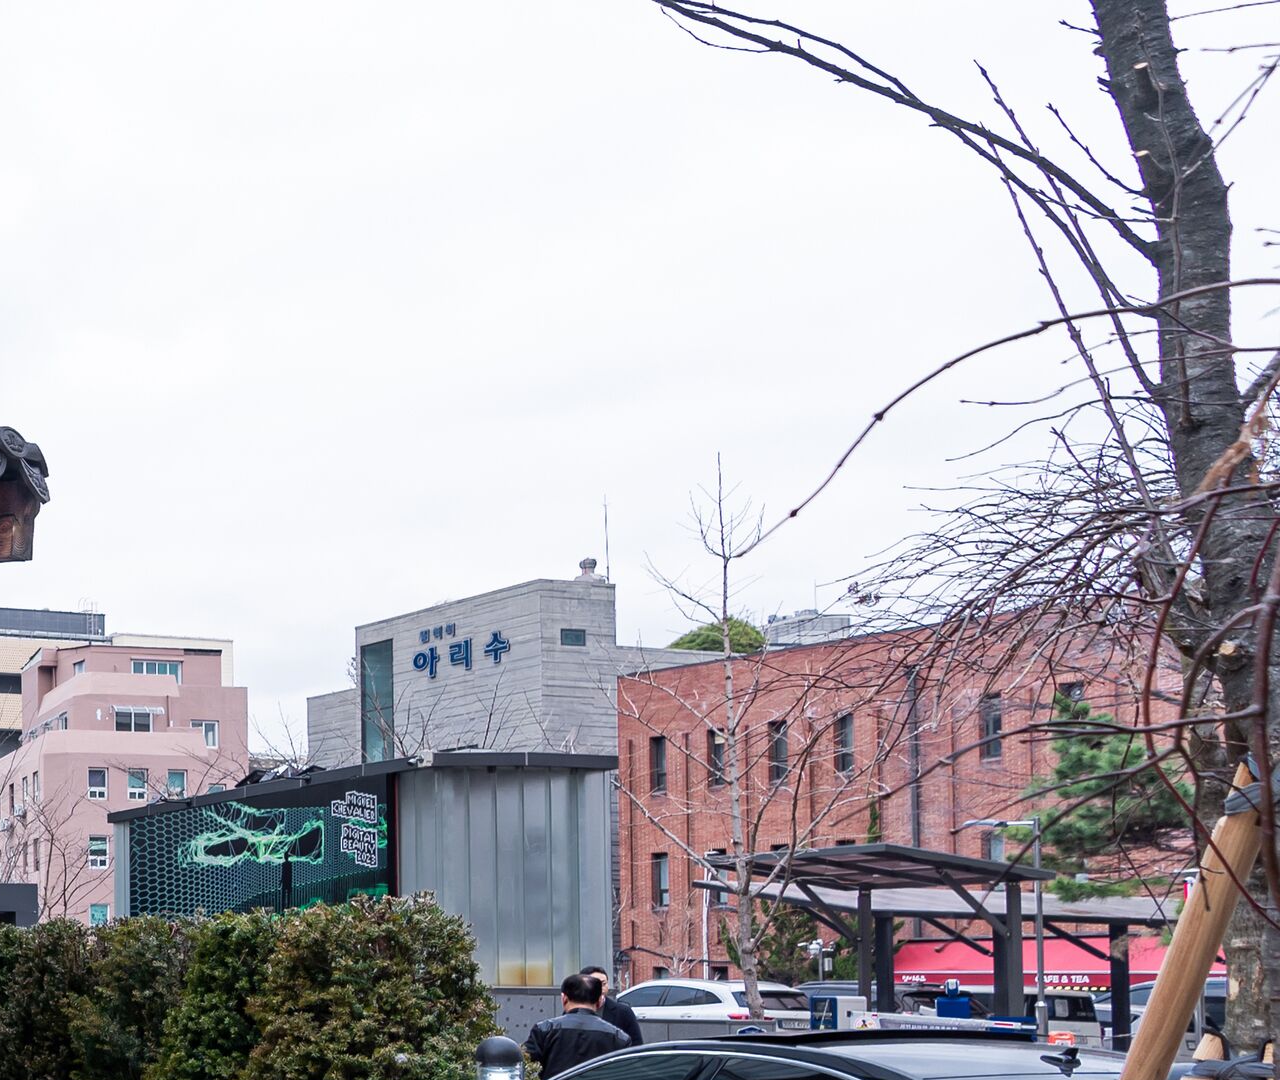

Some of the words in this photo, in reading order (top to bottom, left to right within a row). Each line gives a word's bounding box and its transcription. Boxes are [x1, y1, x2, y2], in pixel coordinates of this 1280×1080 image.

[412, 629, 510, 679] 아리수
[346, 795, 375, 809] MIGUEL
[333, 803, 375, 820] CHEVALIER
[342, 827, 375, 843] DIGITAL
[342, 839, 376, 854] BEAUTY
[357, 851, 376, 865] 2023
[1060, 974, 1068, 984] &
[1071, 974, 1090, 984] TEA
